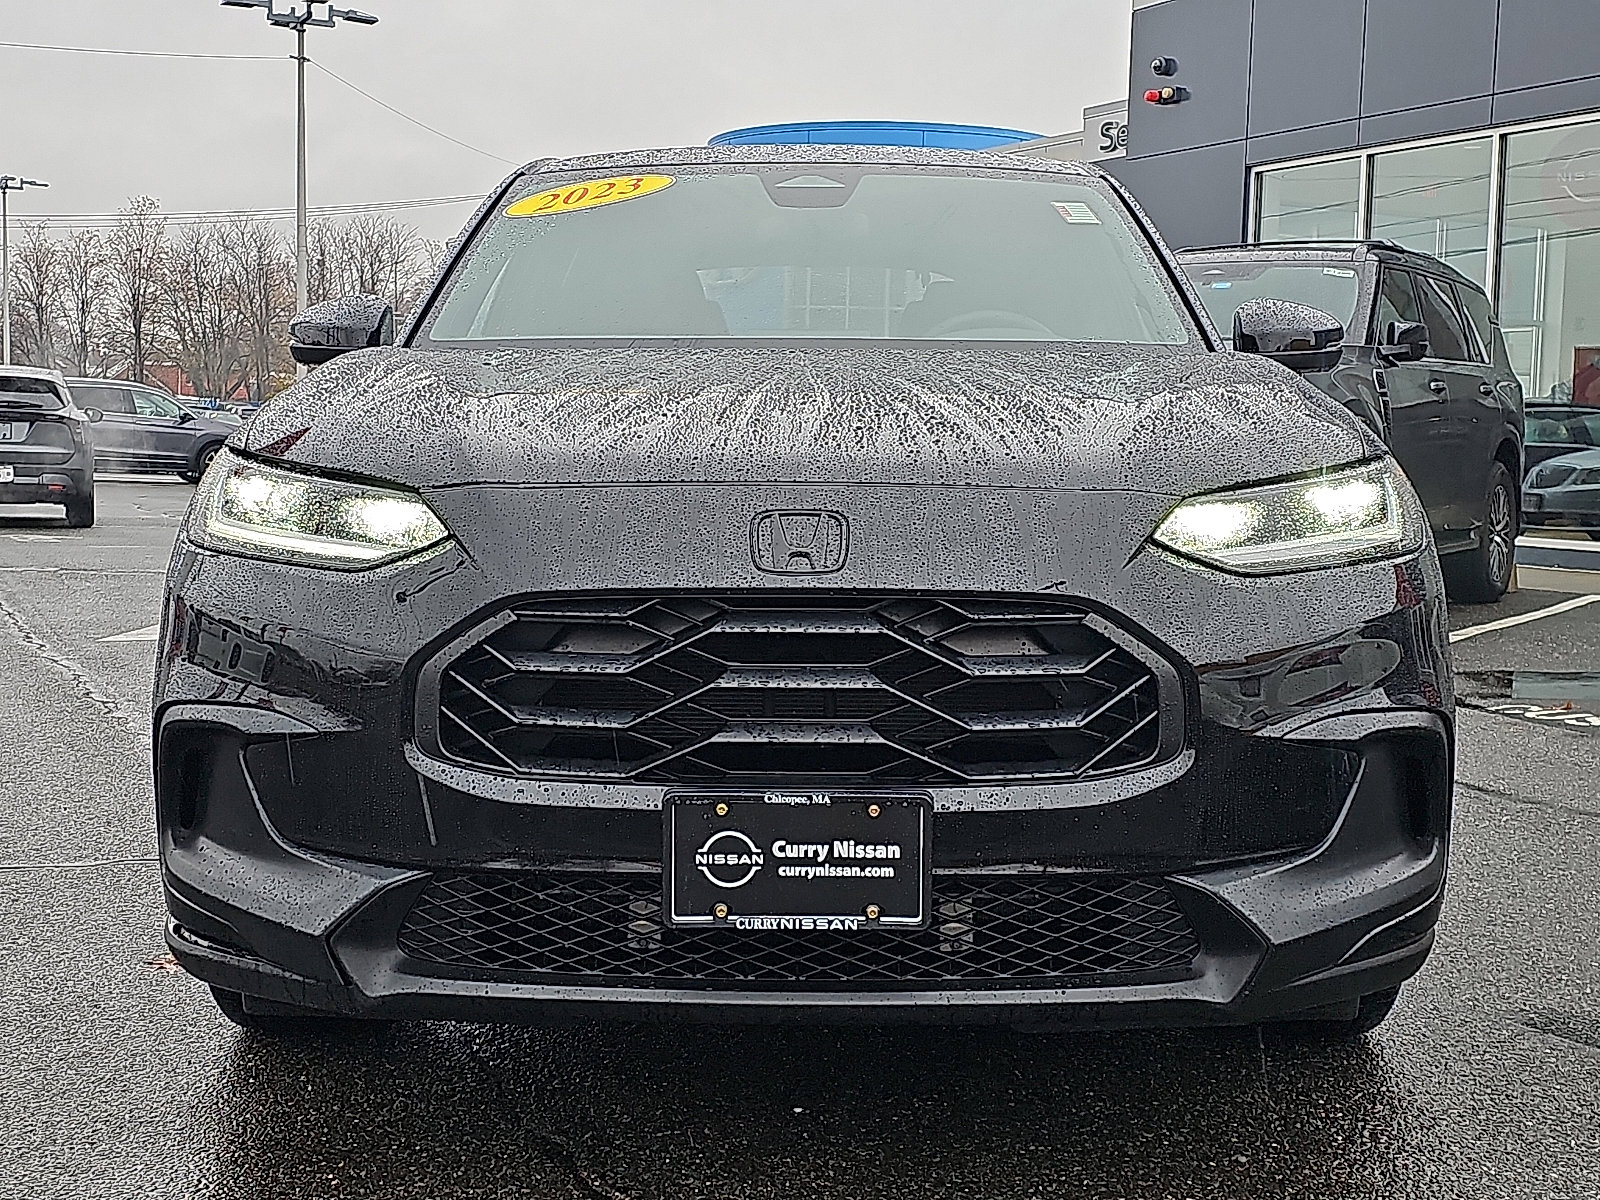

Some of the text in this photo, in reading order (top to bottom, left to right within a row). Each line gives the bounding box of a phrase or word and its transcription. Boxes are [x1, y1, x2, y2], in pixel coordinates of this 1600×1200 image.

[532, 177, 644, 213] 2023
[764, 791, 832, 806] Chicopee, MA
[695, 853, 764, 866] NISSAN
[771, 840, 901, 862] Curry Nissan
[778, 863, 895, 880] currynissan.com
